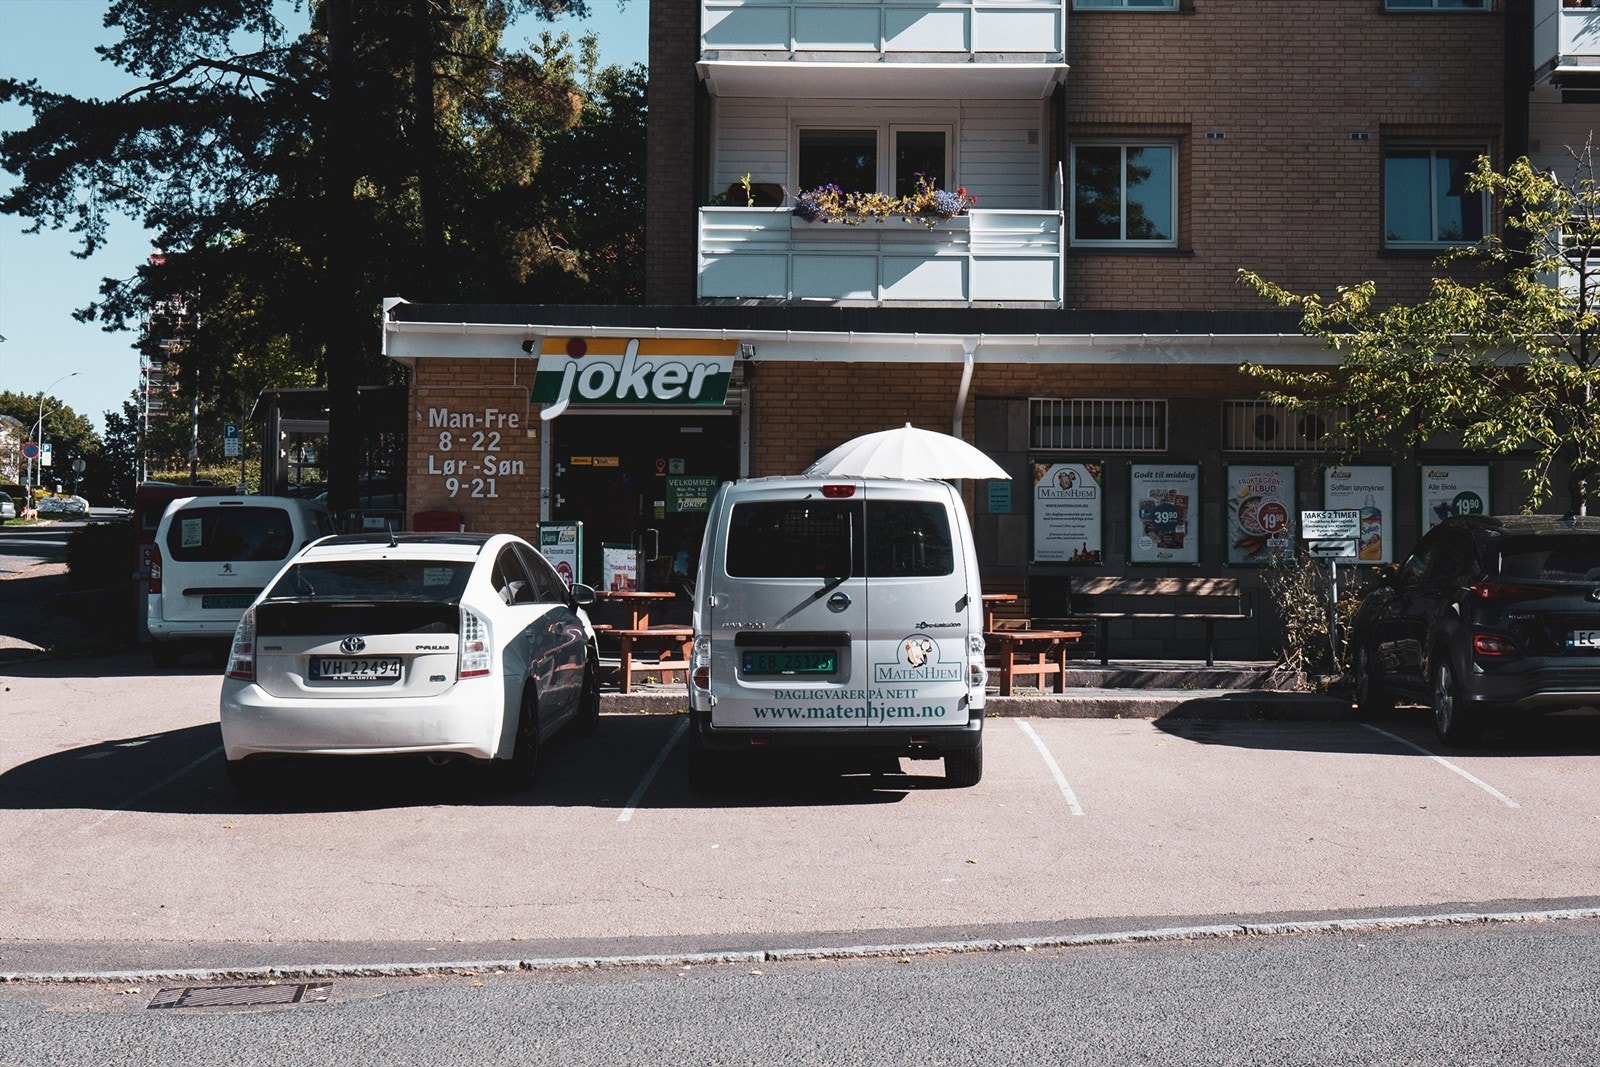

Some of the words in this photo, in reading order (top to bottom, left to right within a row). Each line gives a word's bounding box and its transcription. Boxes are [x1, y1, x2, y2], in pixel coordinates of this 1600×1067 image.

[540, 336, 721, 421] joker
[428, 408, 519, 428] Man-Fre
[227, 426, 235, 437] P
[1133, 471, 1154, 479] Godt
[1155, 471, 1164, 479] til
[1165, 471, 1196, 481] middag
[677, 498, 707, 511] joker
[1579, 632, 1595, 645] EC
[322, 661, 342, 674] VH
[351, 661, 398, 674] 22494
[758, 655, 776, 669] EB
[774, 690, 866, 700] DAGLIGVARER
[868, 688, 884, 699] PÅ
[886, 689, 917, 698] NETT
[753, 701, 945, 723] www.matenhjem.no
